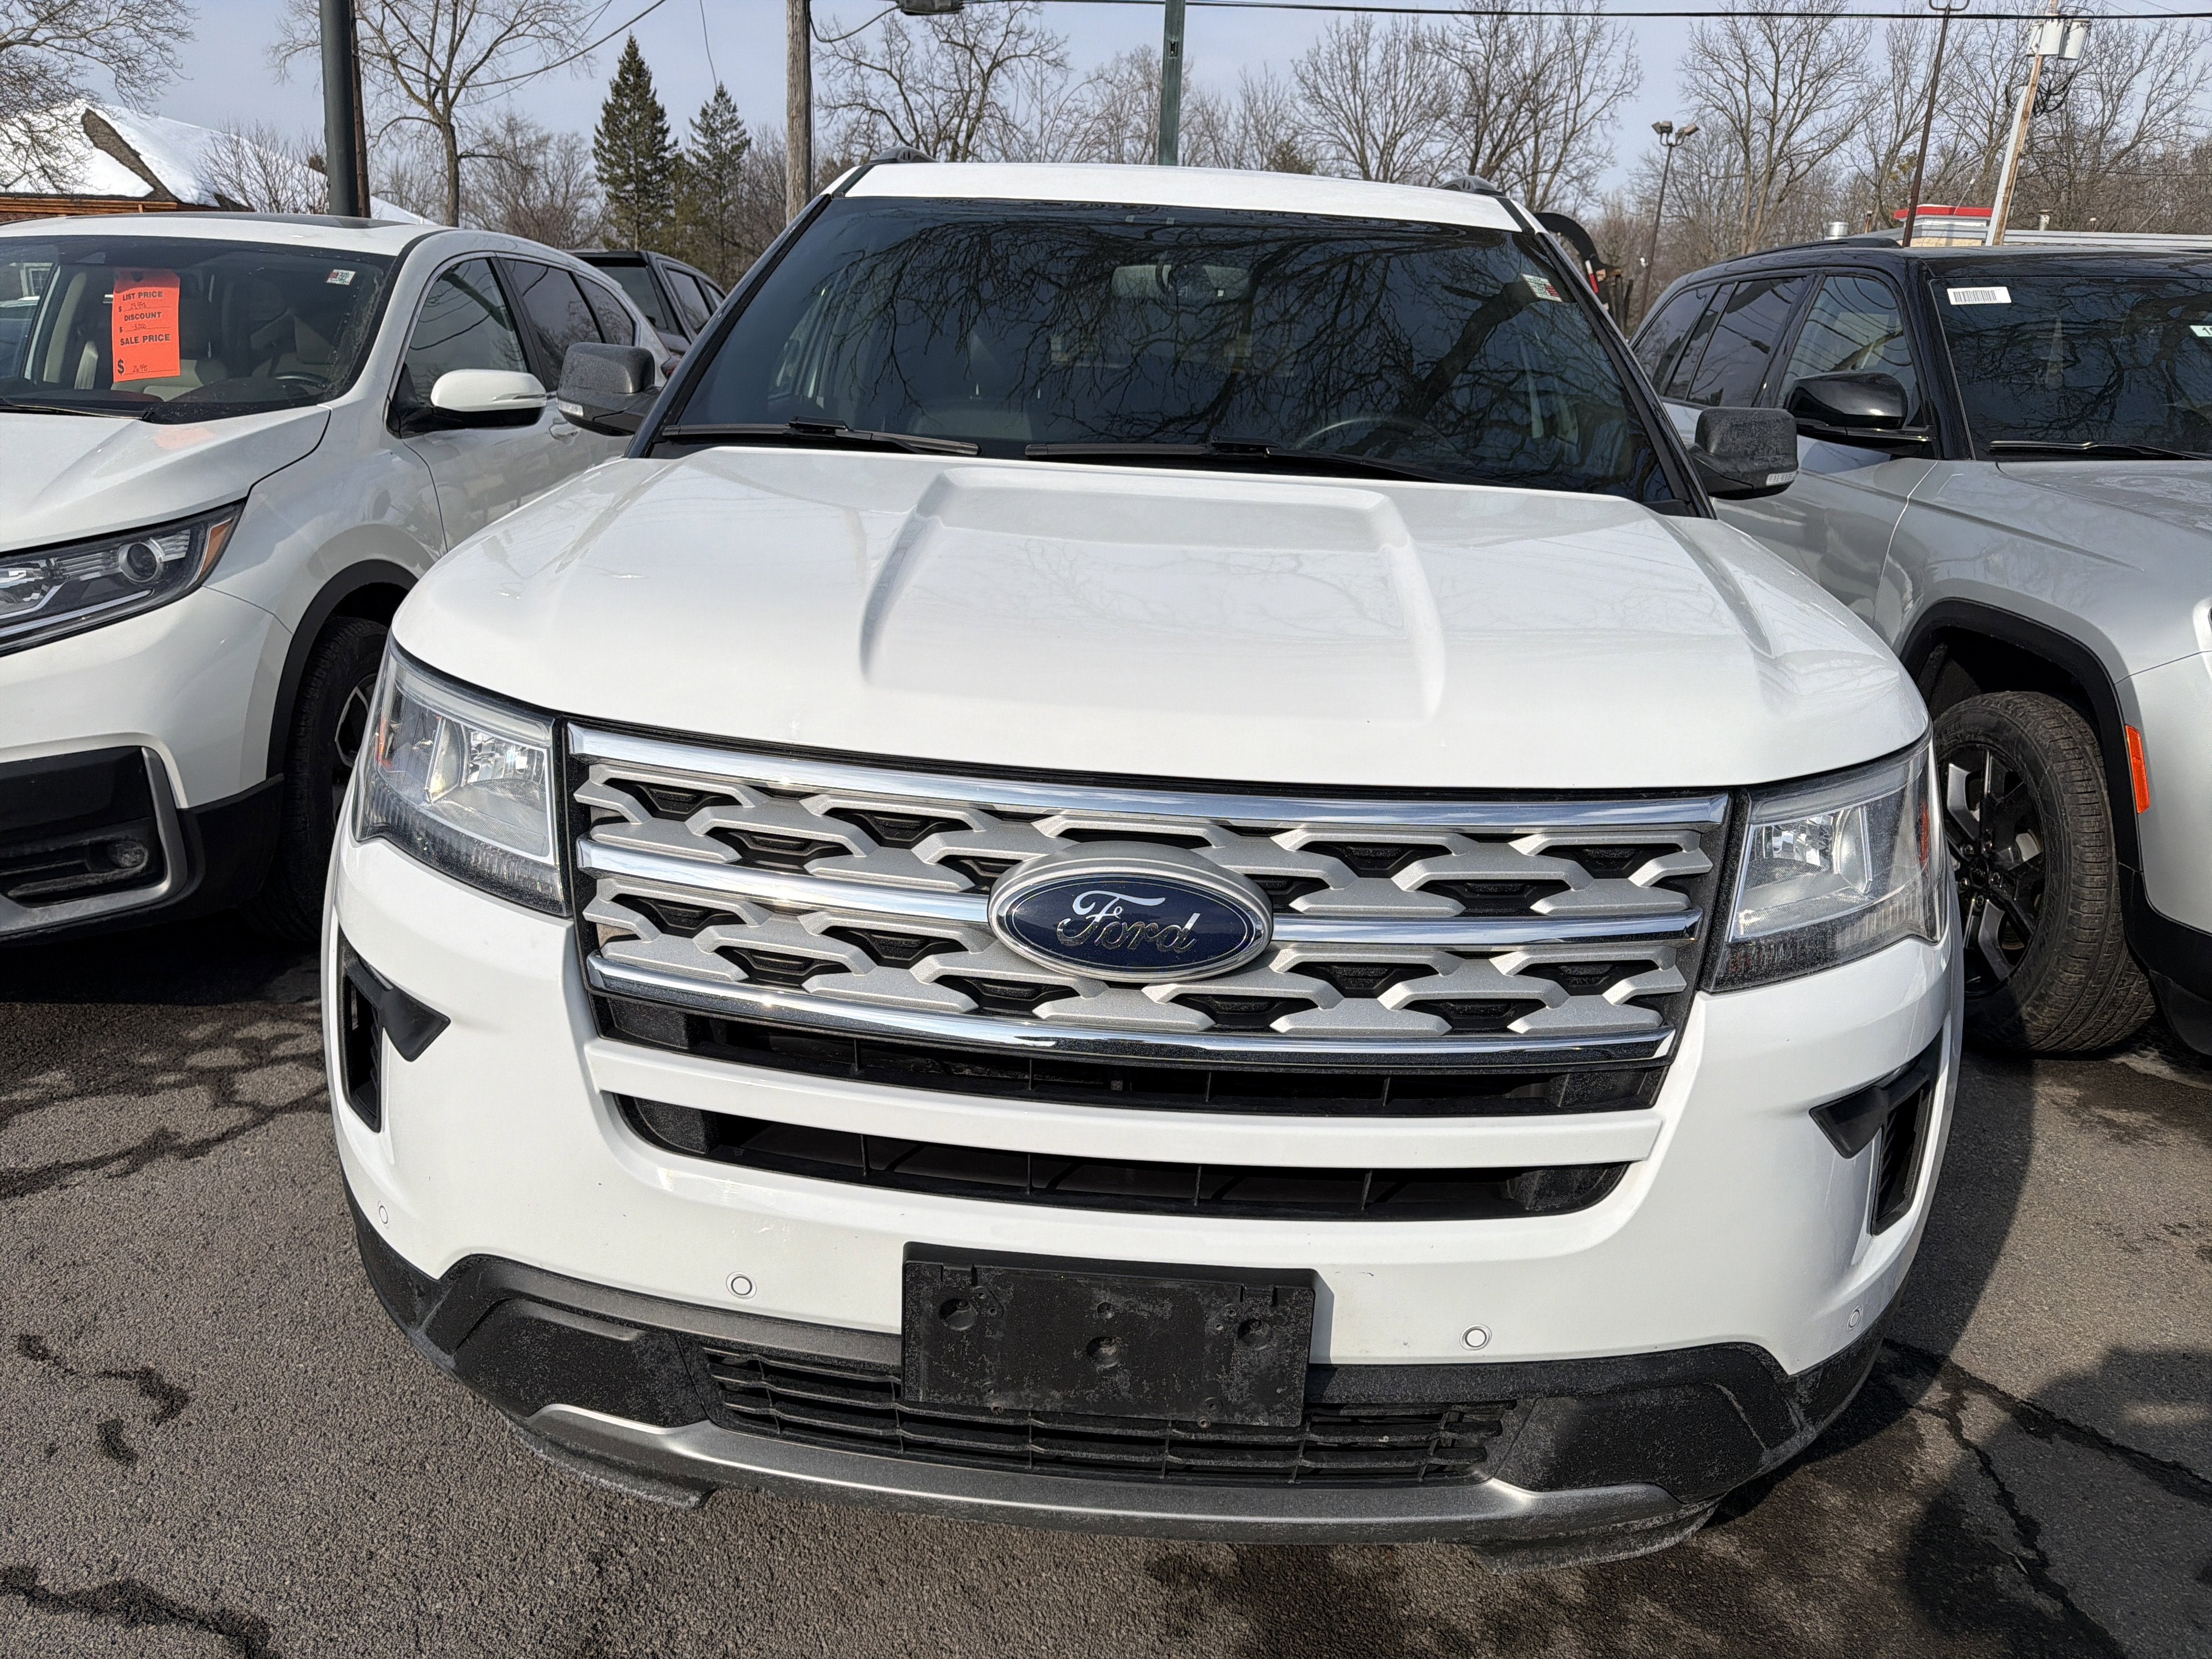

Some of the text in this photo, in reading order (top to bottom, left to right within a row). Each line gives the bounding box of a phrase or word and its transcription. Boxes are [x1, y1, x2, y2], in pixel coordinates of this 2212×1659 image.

[122, 293, 136, 301] LIST
[124, 312, 162, 321] DISCOUNT
[120, 334, 171, 346] SALE PRICE
[117, 358, 125, 376] $
[1056, 890, 1201, 953] Ford
